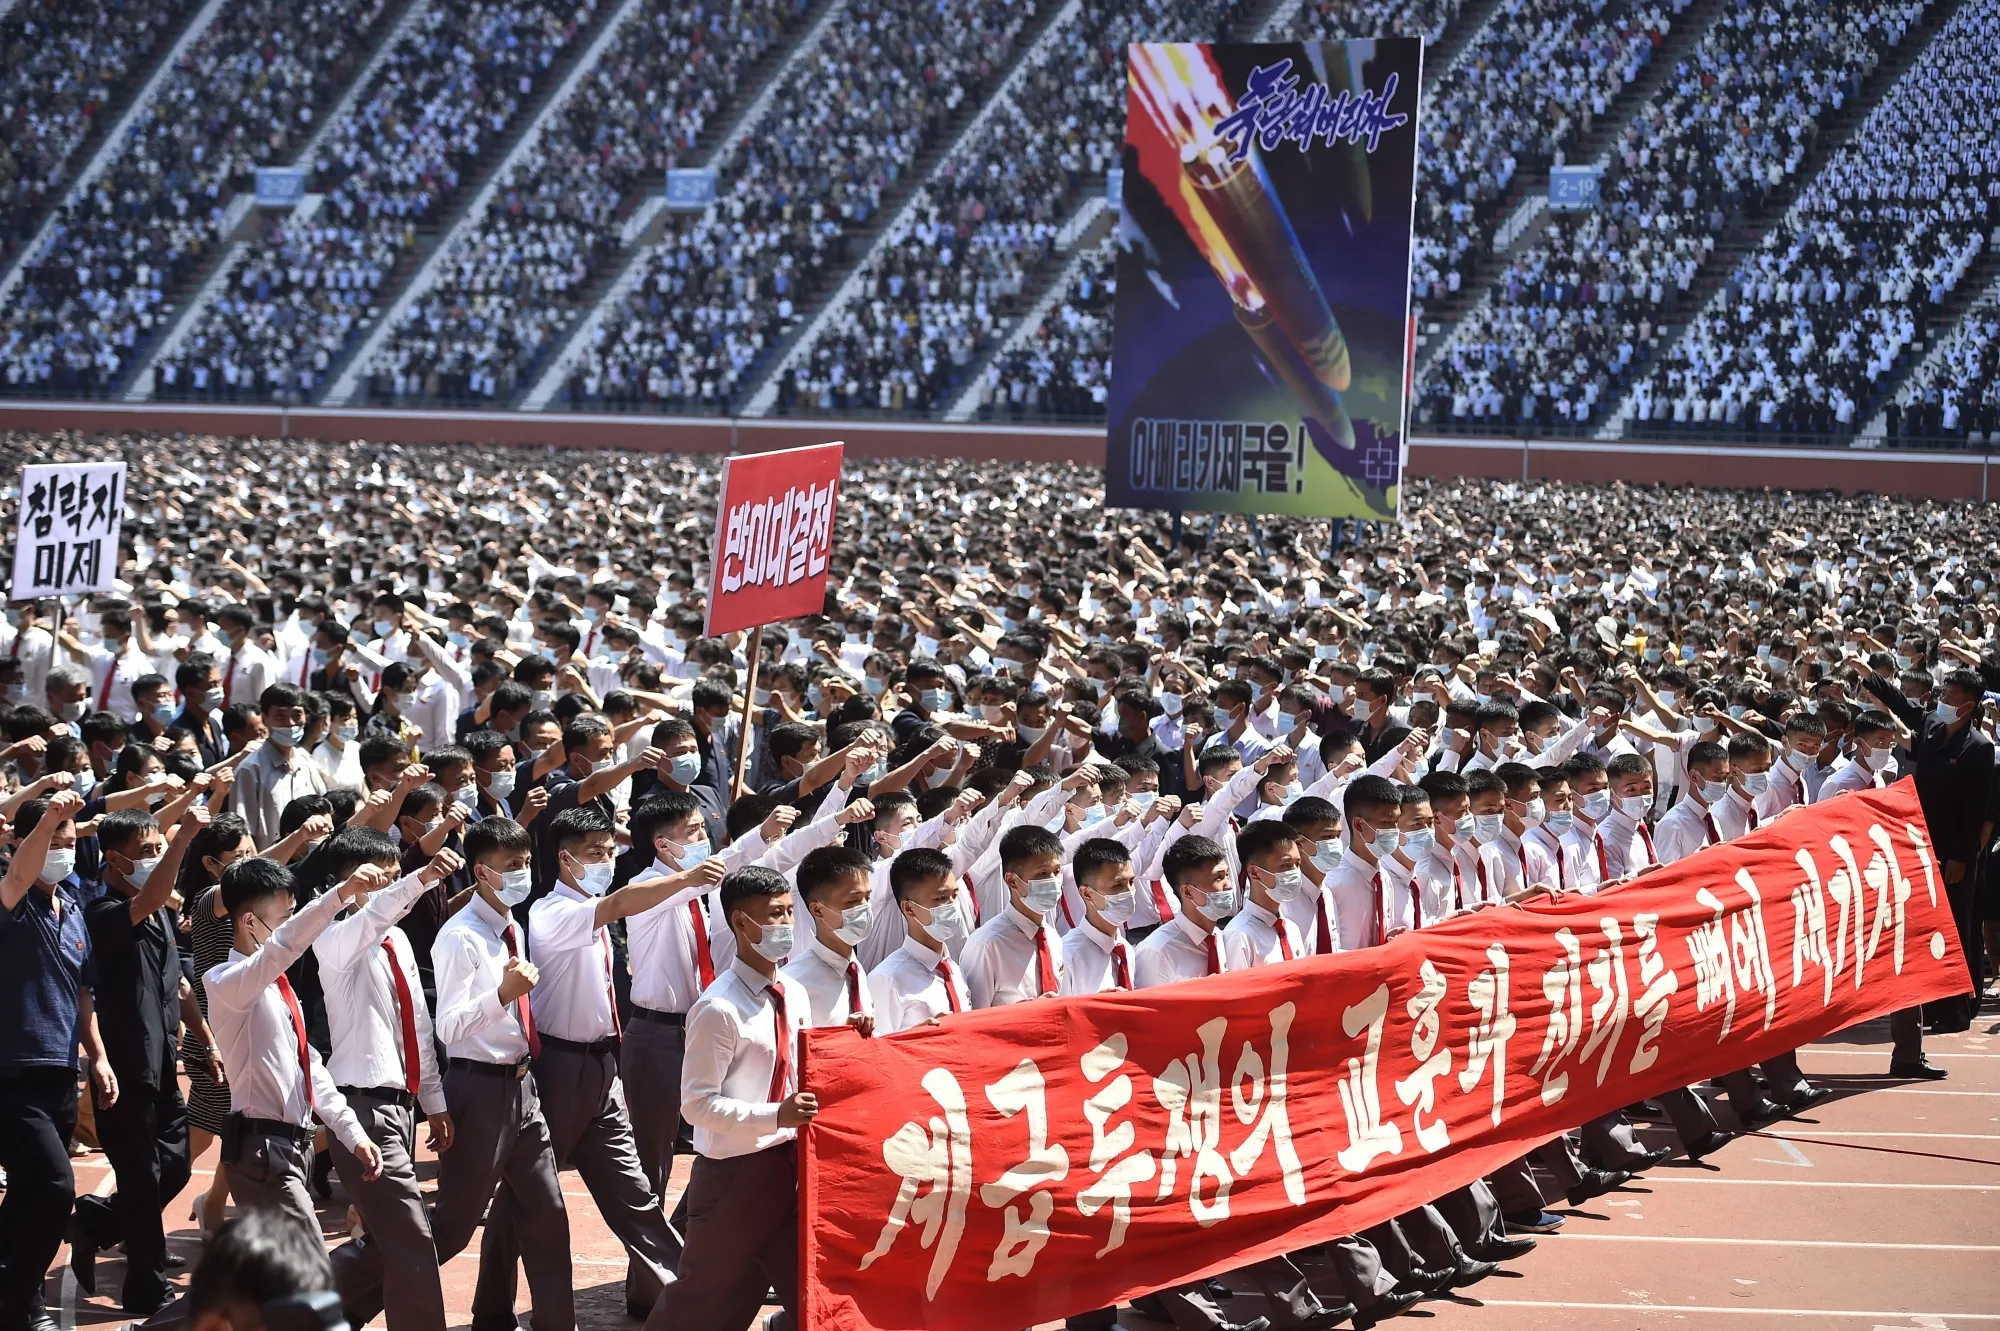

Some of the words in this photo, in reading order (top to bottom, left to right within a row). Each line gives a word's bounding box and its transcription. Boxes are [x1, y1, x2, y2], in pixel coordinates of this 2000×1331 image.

[1557, 177, 1595, 198] 2-19
[23, 472, 119, 539] 침략자
[721, 478, 836, 594] 반미대결전
[33, 538, 102, 590] 미제
[857, 1000, 1307, 1302] 계급투쟁의
[1337, 942, 1517, 1173] 교훈과
[1685, 867, 1777, 1045] 뼈에
[1790, 822, 1946, 1008] 새기자!
